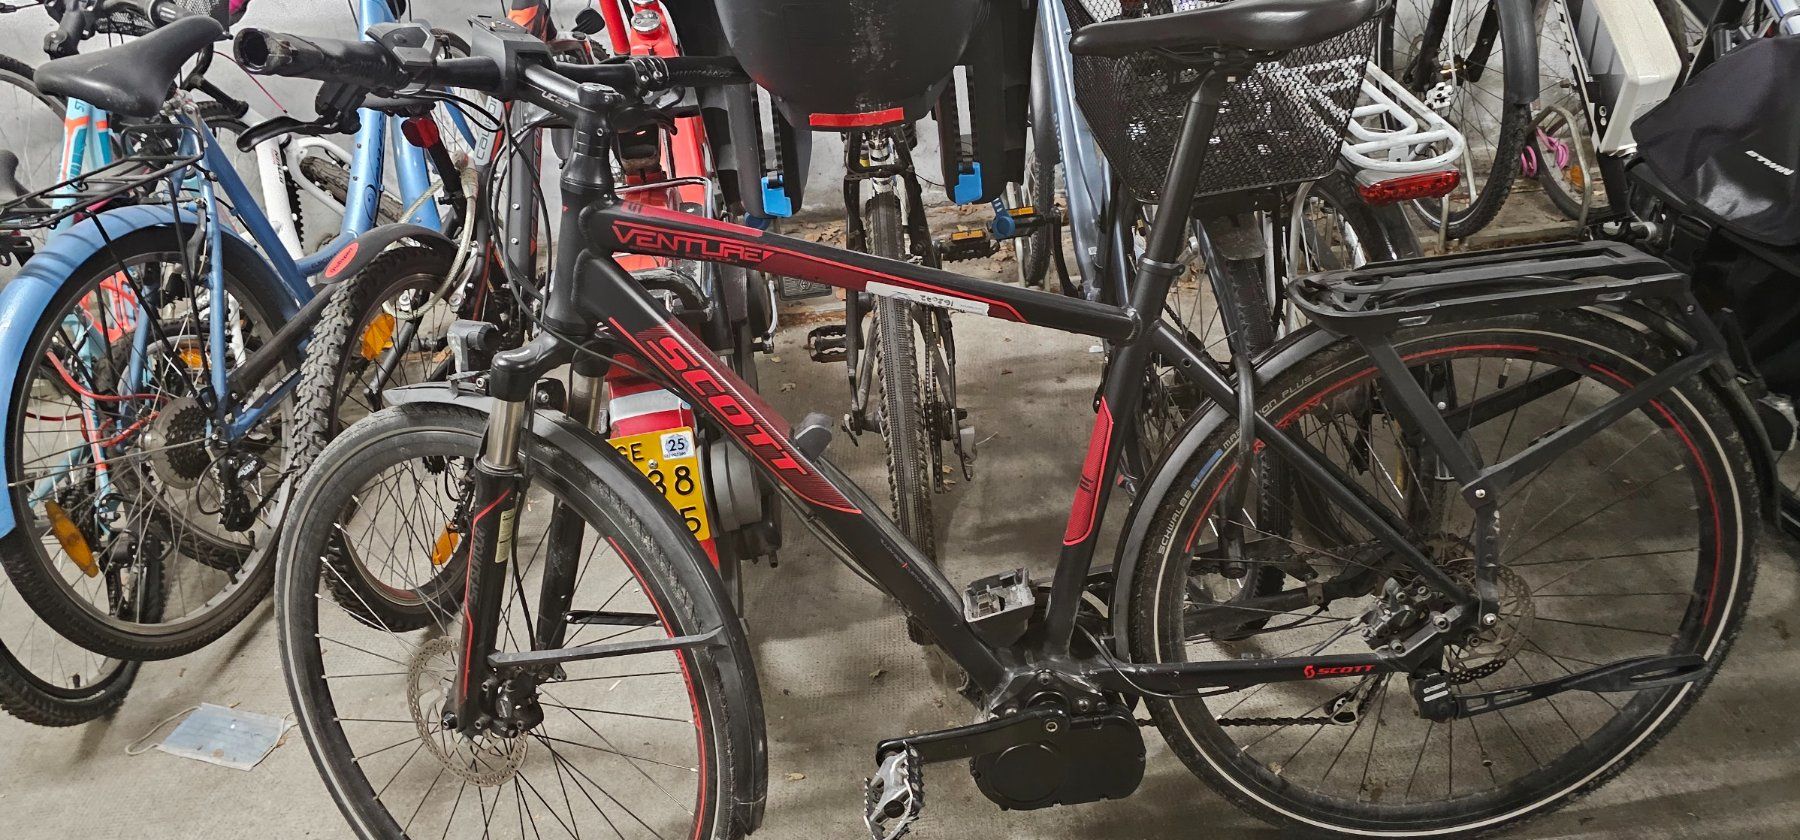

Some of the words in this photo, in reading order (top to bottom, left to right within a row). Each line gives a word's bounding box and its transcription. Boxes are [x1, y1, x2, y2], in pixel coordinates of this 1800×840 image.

[612, 225, 762, 263] VENTURE
[660, 337, 808, 475] SCOTT
[668, 438, 686, 452] 25
[1157, 489, 1192, 555] SCHWALBE
[1281, 374, 1313, 398] PLUS
[1316, 664, 1377, 675] SCOTT
